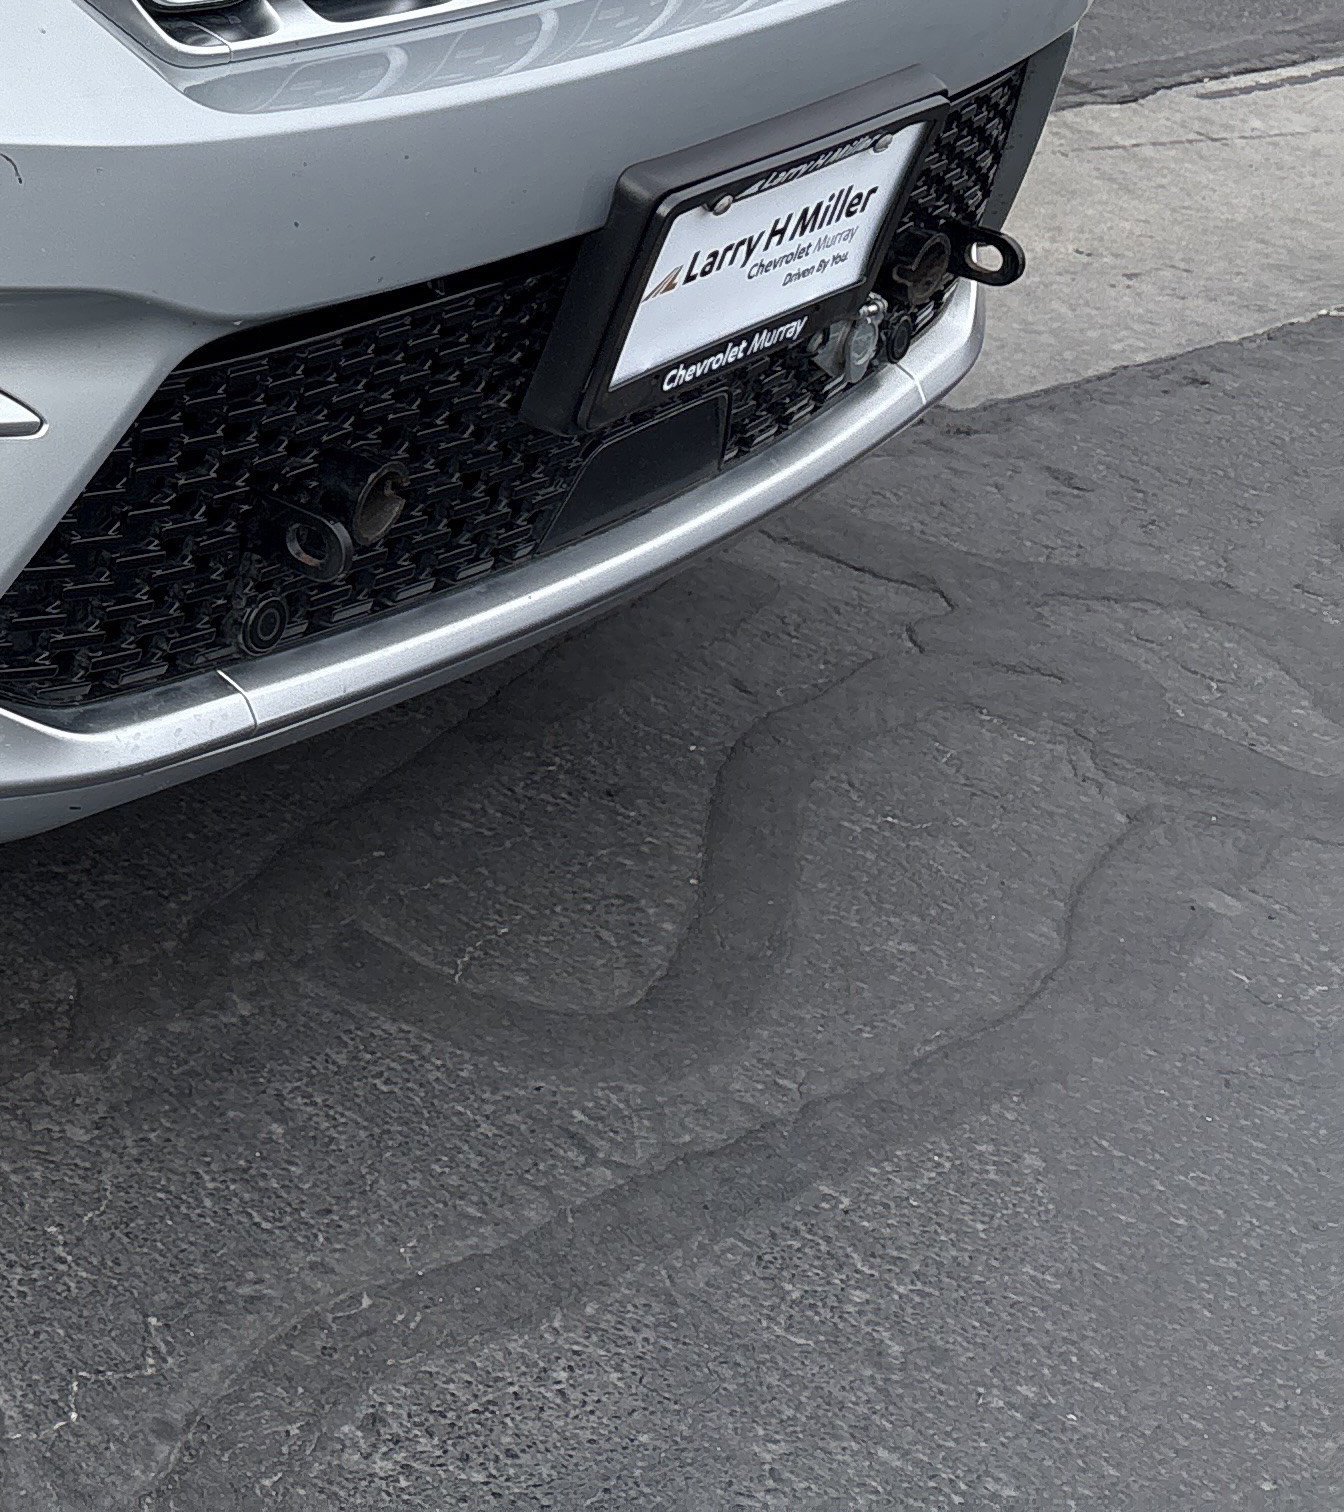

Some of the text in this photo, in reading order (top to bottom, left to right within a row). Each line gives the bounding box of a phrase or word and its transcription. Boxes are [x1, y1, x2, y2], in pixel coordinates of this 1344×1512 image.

[762, 162, 814, 190] Larry
[810, 153, 829, 172] H
[682, 185, 879, 285] Larry H Miller
[747, 226, 859, 280] Chevrolet Murray
[782, 266, 814, 287] Driven
[815, 259, 830, 274] By
[662, 316, 809, 392] Chevrolet Murray
